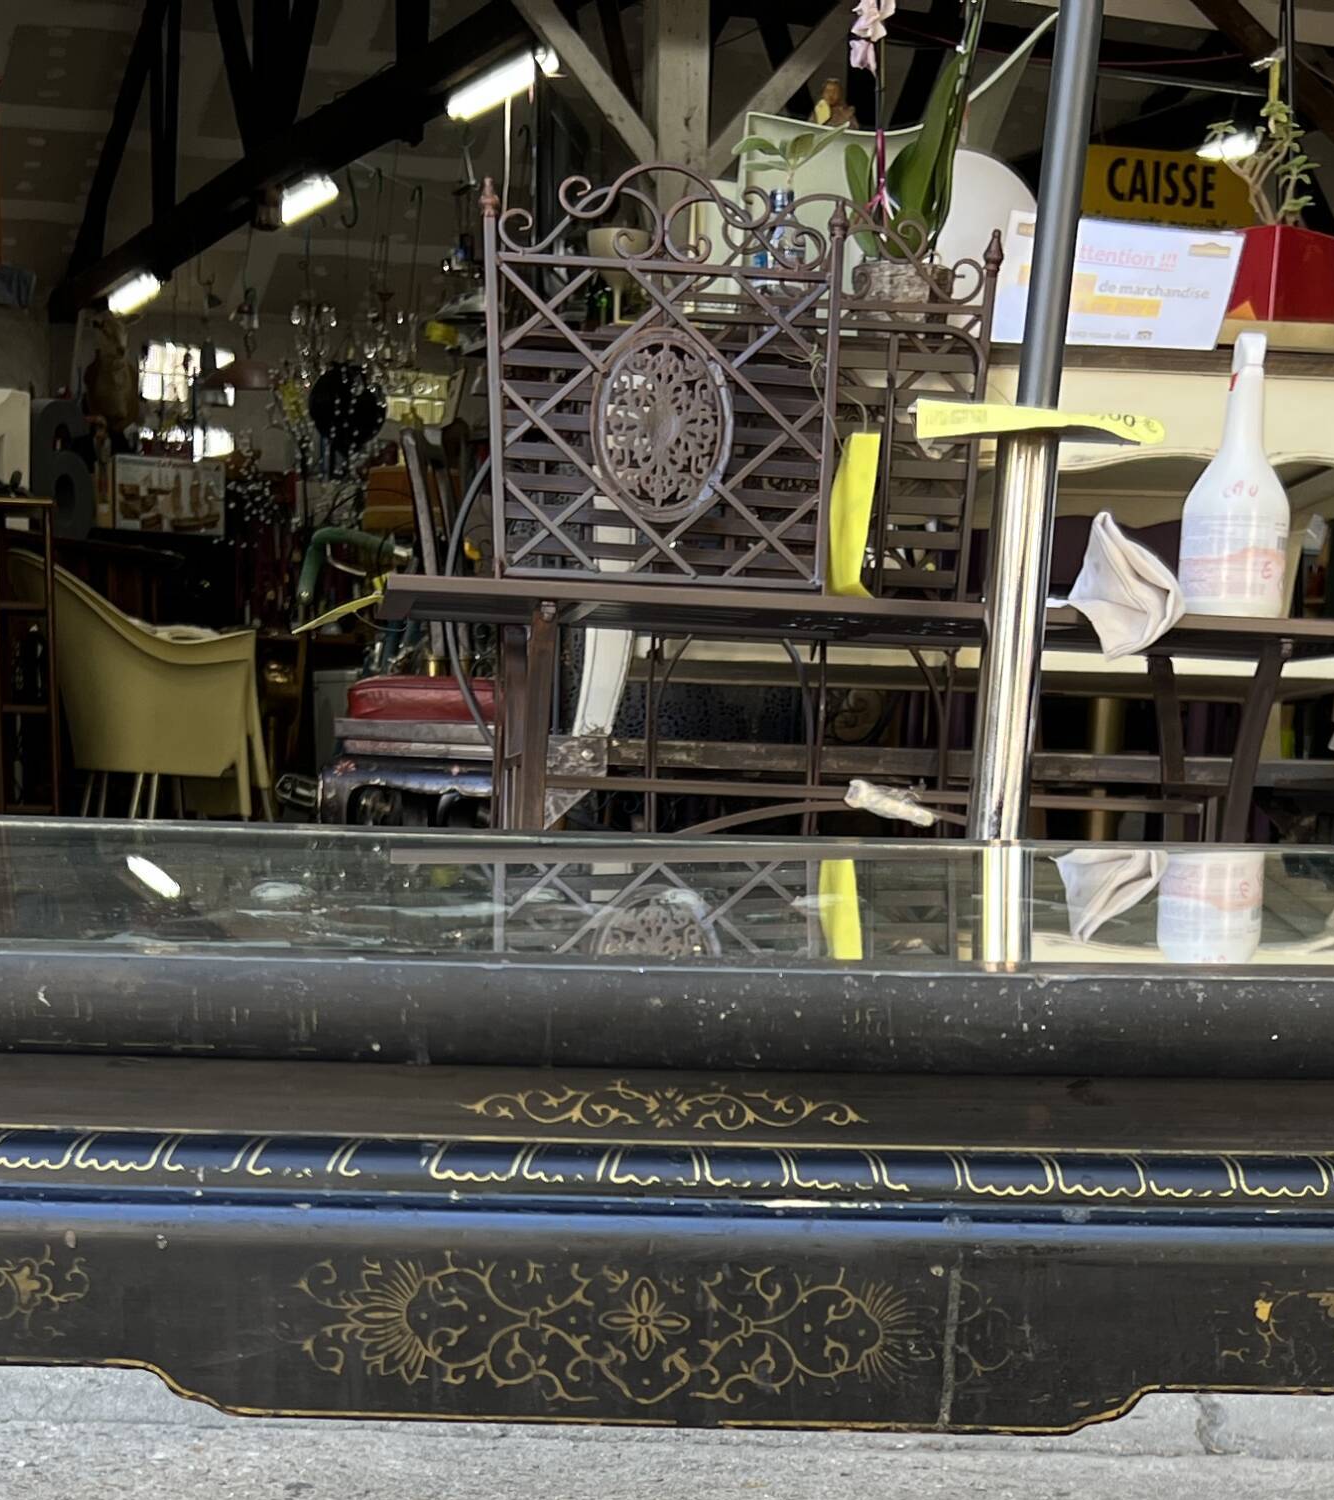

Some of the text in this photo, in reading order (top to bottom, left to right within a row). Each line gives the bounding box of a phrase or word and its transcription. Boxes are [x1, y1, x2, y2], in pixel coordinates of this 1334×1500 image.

[1107, 157, 1216, 209] CAISSE
[1078, 244, 1155, 267] ttention
[1098, 280, 1212, 300] de marchandise
